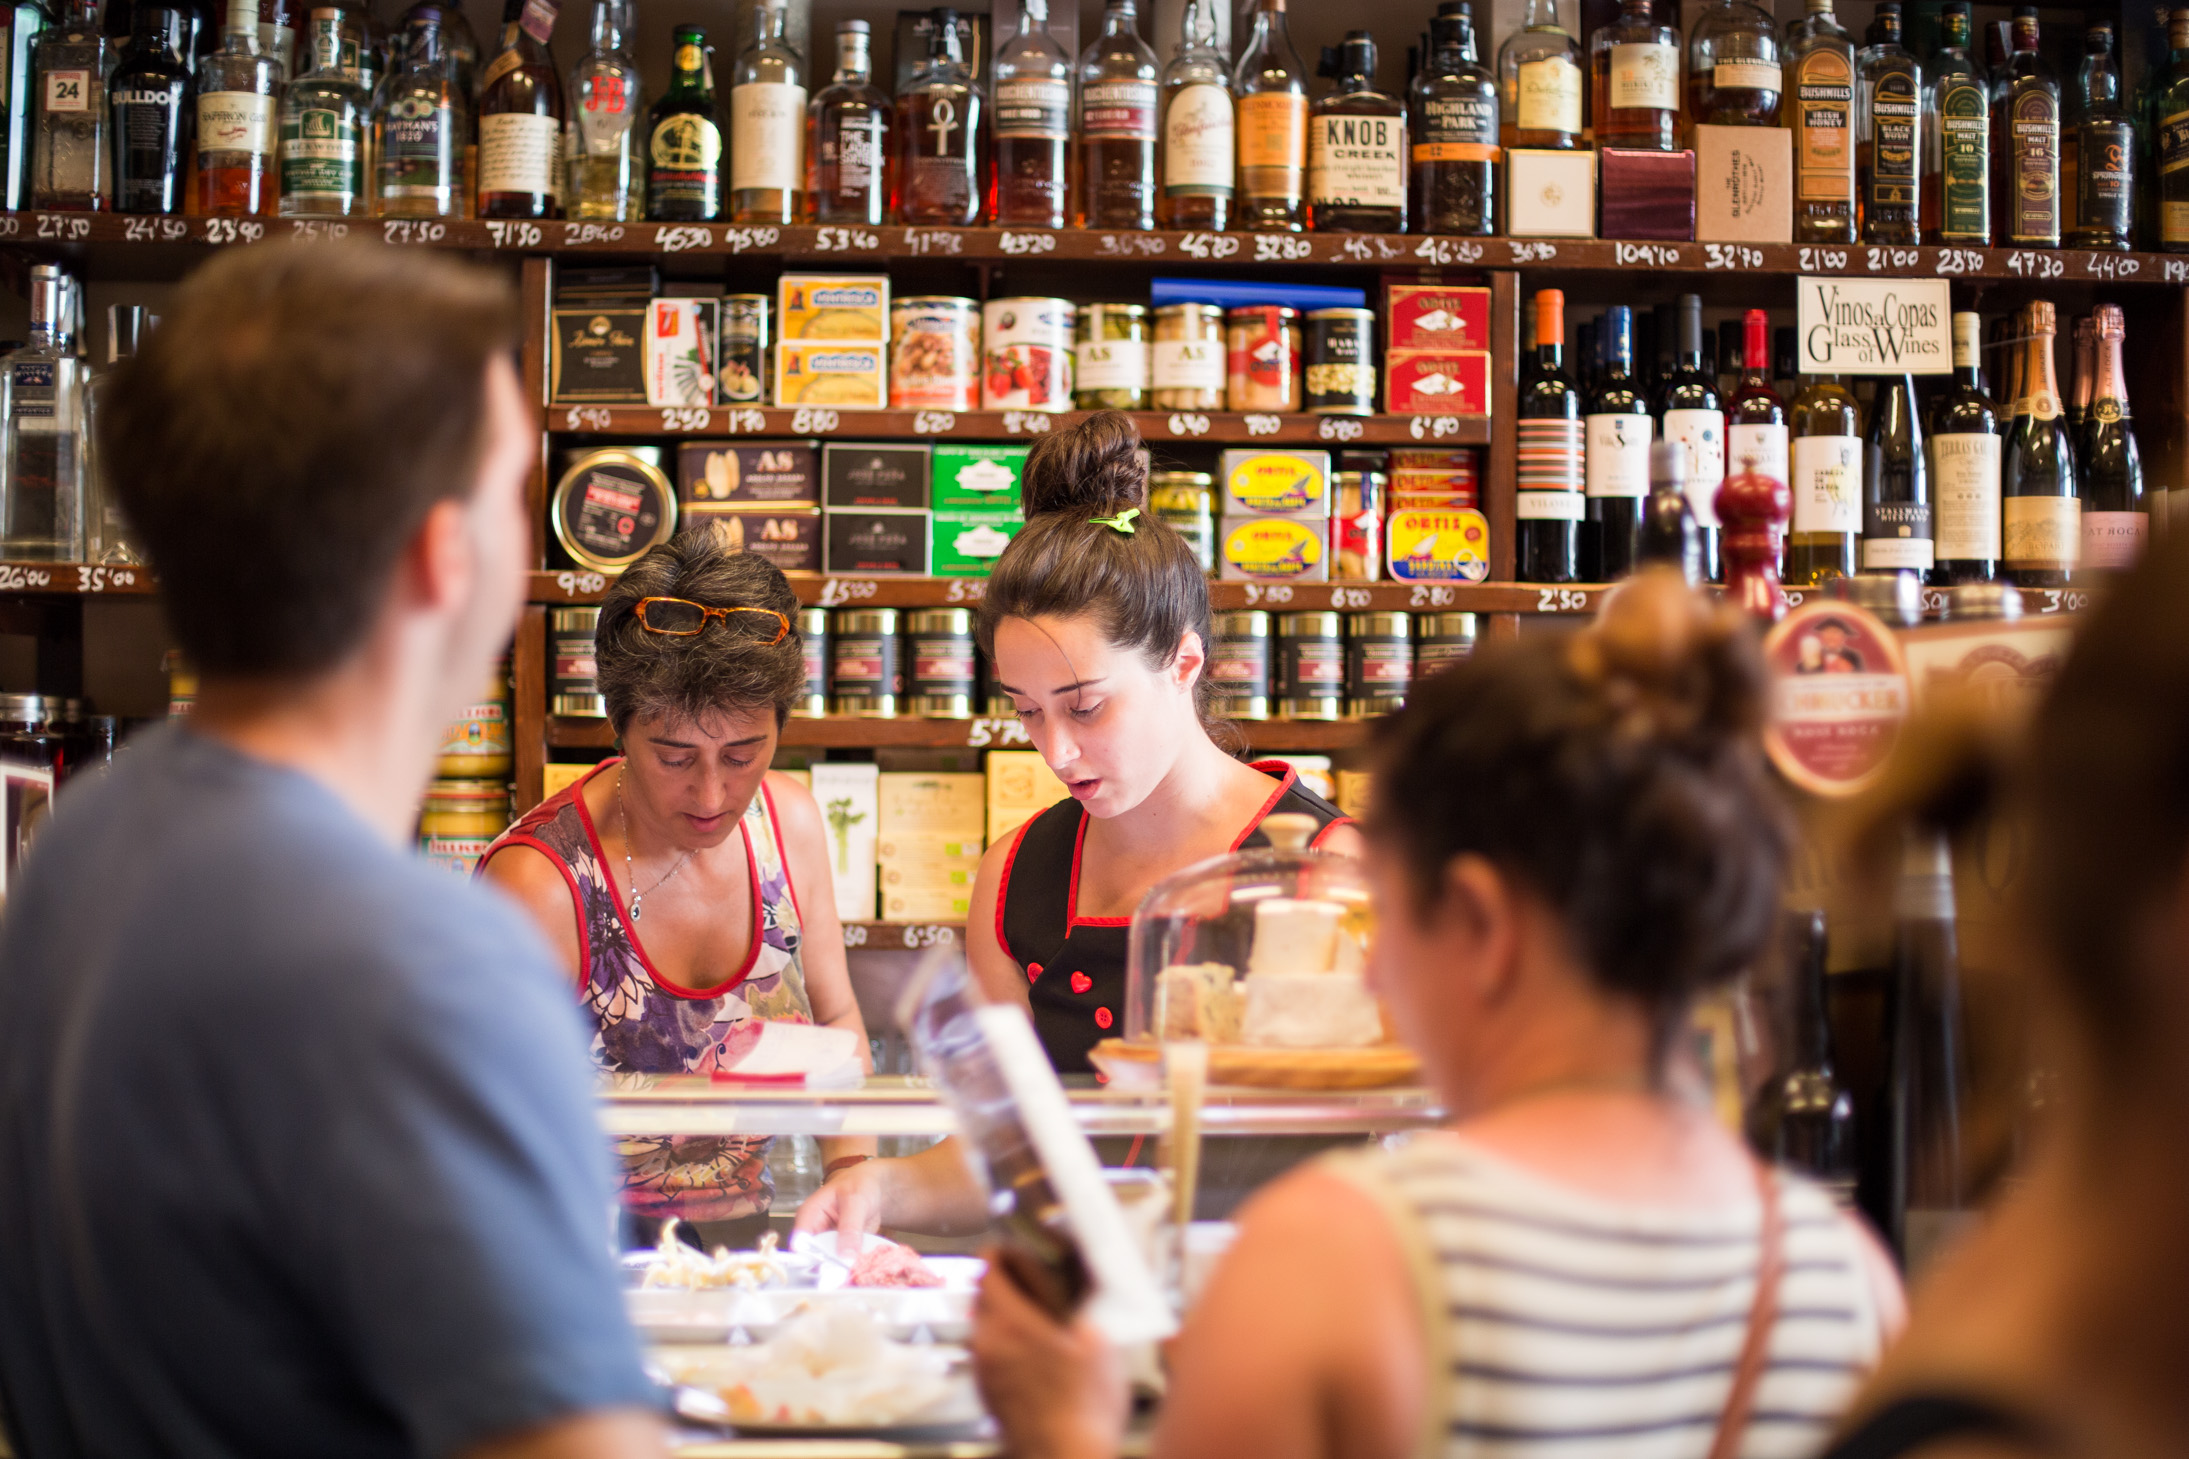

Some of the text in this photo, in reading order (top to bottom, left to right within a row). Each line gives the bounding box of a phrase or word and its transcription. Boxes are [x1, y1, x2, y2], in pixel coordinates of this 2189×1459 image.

[55, 82, 80, 99] 24
[1800, 86, 1850, 100] BUSHMILLS
[1425, 101, 1494, 117] HIGHLAND
[1874, 102, 1919, 116] BUSHMILLS
[1327, 119, 1387, 146] KNOB
[1441, 116, 1478, 130] PARK
[1946, 119, 1986, 131] BUSHMILLS
[2016, 123, 2057, 135] BUSHMILLS
[1333, 149, 1396, 160] CREEK
[1960, 144, 1974, 154] 10
[37, 214, 91, 240] 27'50
[123, 216, 188, 242] 24'50
[205, 217, 265, 244] 23'90
[383, 219, 447, 245] 27'50
[1798, 247, 1848, 272] 21'00
[1867, 247, 1919, 272] 21'00
[1936, 248, 1984, 276] 28'50
[2007, 250, 2065, 279] 47'30
[2086, 253, 2140, 281] 44'00
[1816, 285, 1938, 338] Vinos a Copas
[1807, 323, 1940, 365] Glass of Wines
[756, 451, 795, 473] AS
[760, 518, 799, 542] AS
[1405, 517, 1461, 531] ORTIZ
[77, 565, 136, 592] 35'00
[1537, 588, 1587, 612] 2'50
[2040, 588, 2089, 614] 3'00
